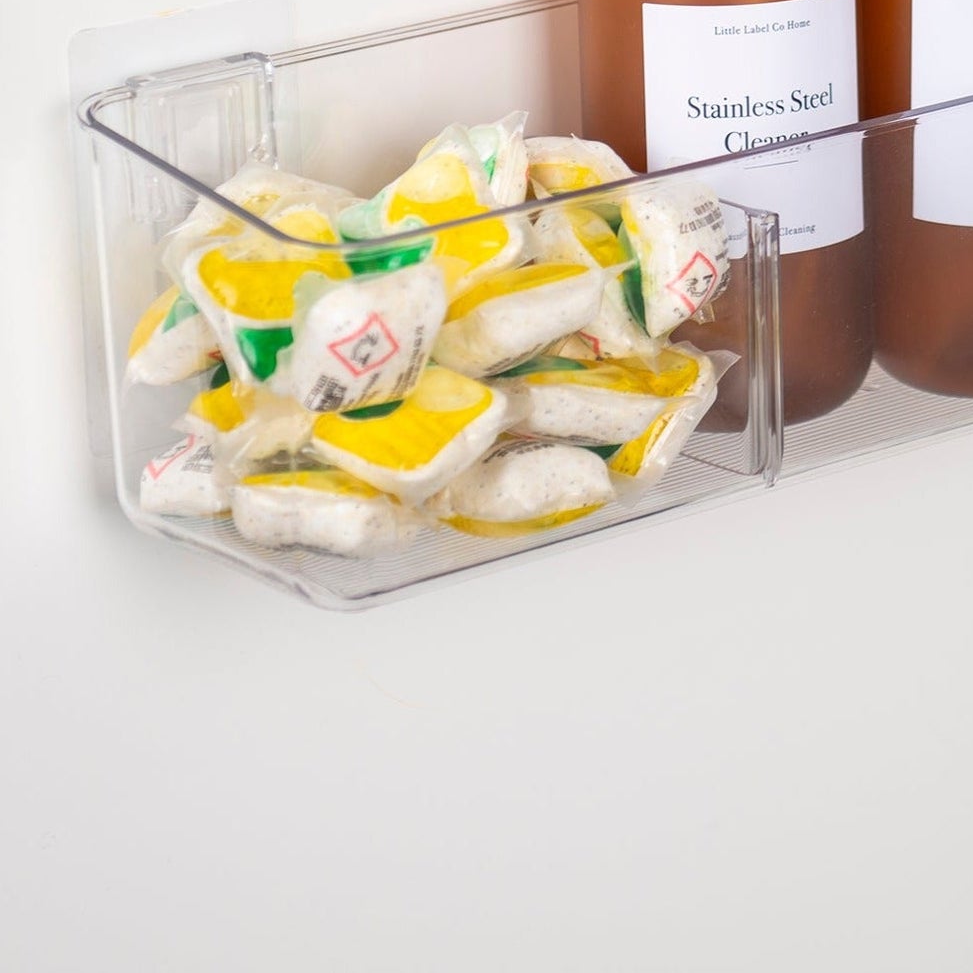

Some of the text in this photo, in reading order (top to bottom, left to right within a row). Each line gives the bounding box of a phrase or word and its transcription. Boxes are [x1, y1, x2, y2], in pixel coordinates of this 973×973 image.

[714, 18, 811, 36] Little Label Co Home
[687, 82, 834, 119] Stainless Steel
[778, 223, 816, 238] Cleaning
